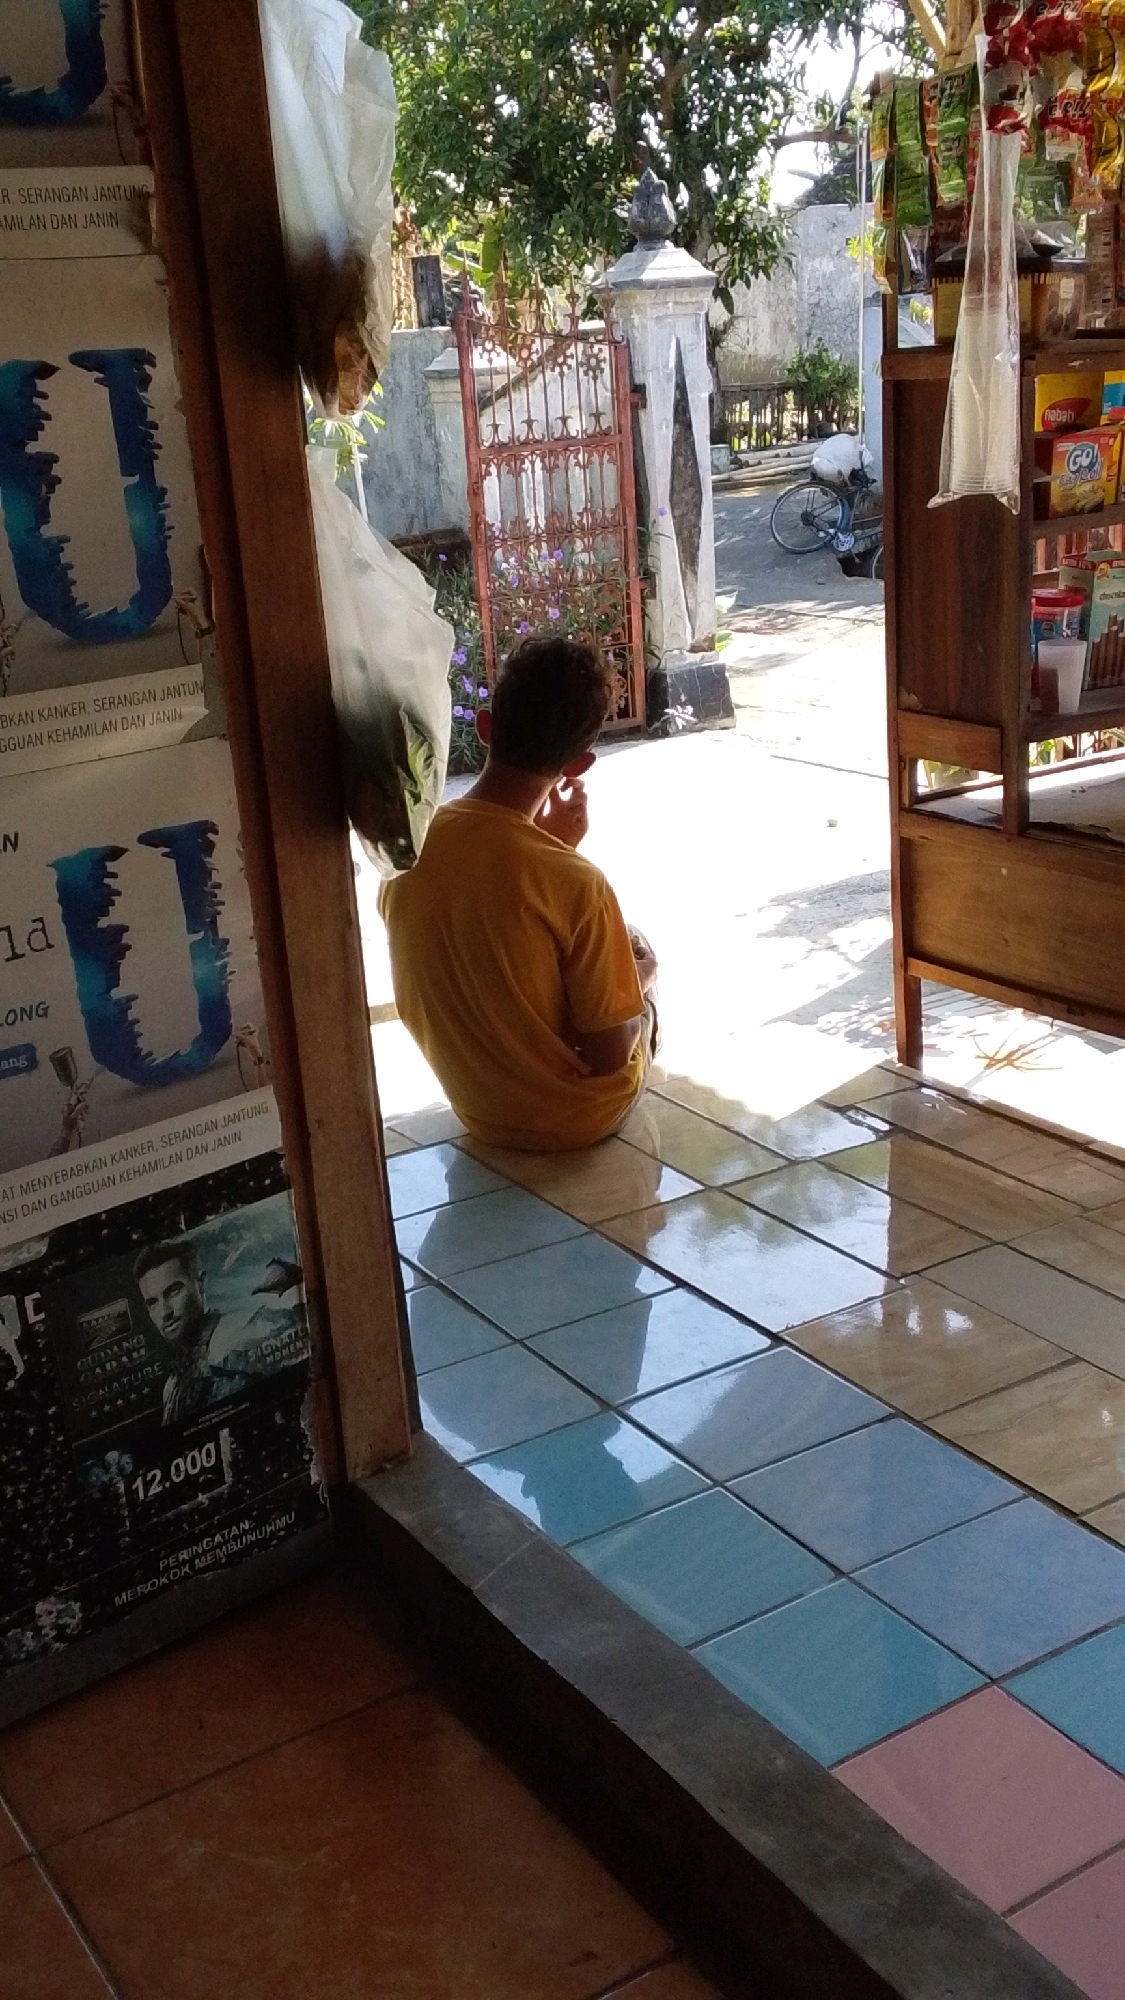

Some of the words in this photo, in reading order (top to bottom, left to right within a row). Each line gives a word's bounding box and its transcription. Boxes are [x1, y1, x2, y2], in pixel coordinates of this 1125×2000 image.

[18, 185, 88, 204] SERANGAN
[50, 212, 78, 230] DAN
[82, 210, 119, 229] JANIN
[0, 709, 35, 729] BKAN
[37, 701, 90, 722] KANKER,
[93, 689, 157, 713] SERANGAN
[47, 719, 118, 744] KEHAMILAN
[121, 713, 146, 731] DAN
[149, 706, 183, 726] JANIN
[46, 819, 233, 1088] U
[19, 1156, 108, 1197] MENYEBABKAN
[110, 1139, 159, 1166] KANKER,
[160, 1120, 219, 1148] SERANGAN
[220, 1101, 272, 1132] JANTUNG,
[21, 1197, 48, 1218] DAN
[50, 1176, 117, 1208] GANGGUAN
[119, 1150, 183, 1184] KEHAMILAN
[186, 1142, 209, 1161] DAN
[211, 1131, 242, 1152] JANIN
[72, 1362, 163, 1412] SIGNATURE
[132, 1442, 216, 1501] 12.000
[114, 1566, 192, 1607] MEROKOK
[194, 1511, 296, 1570] MEMBUNUHMU
